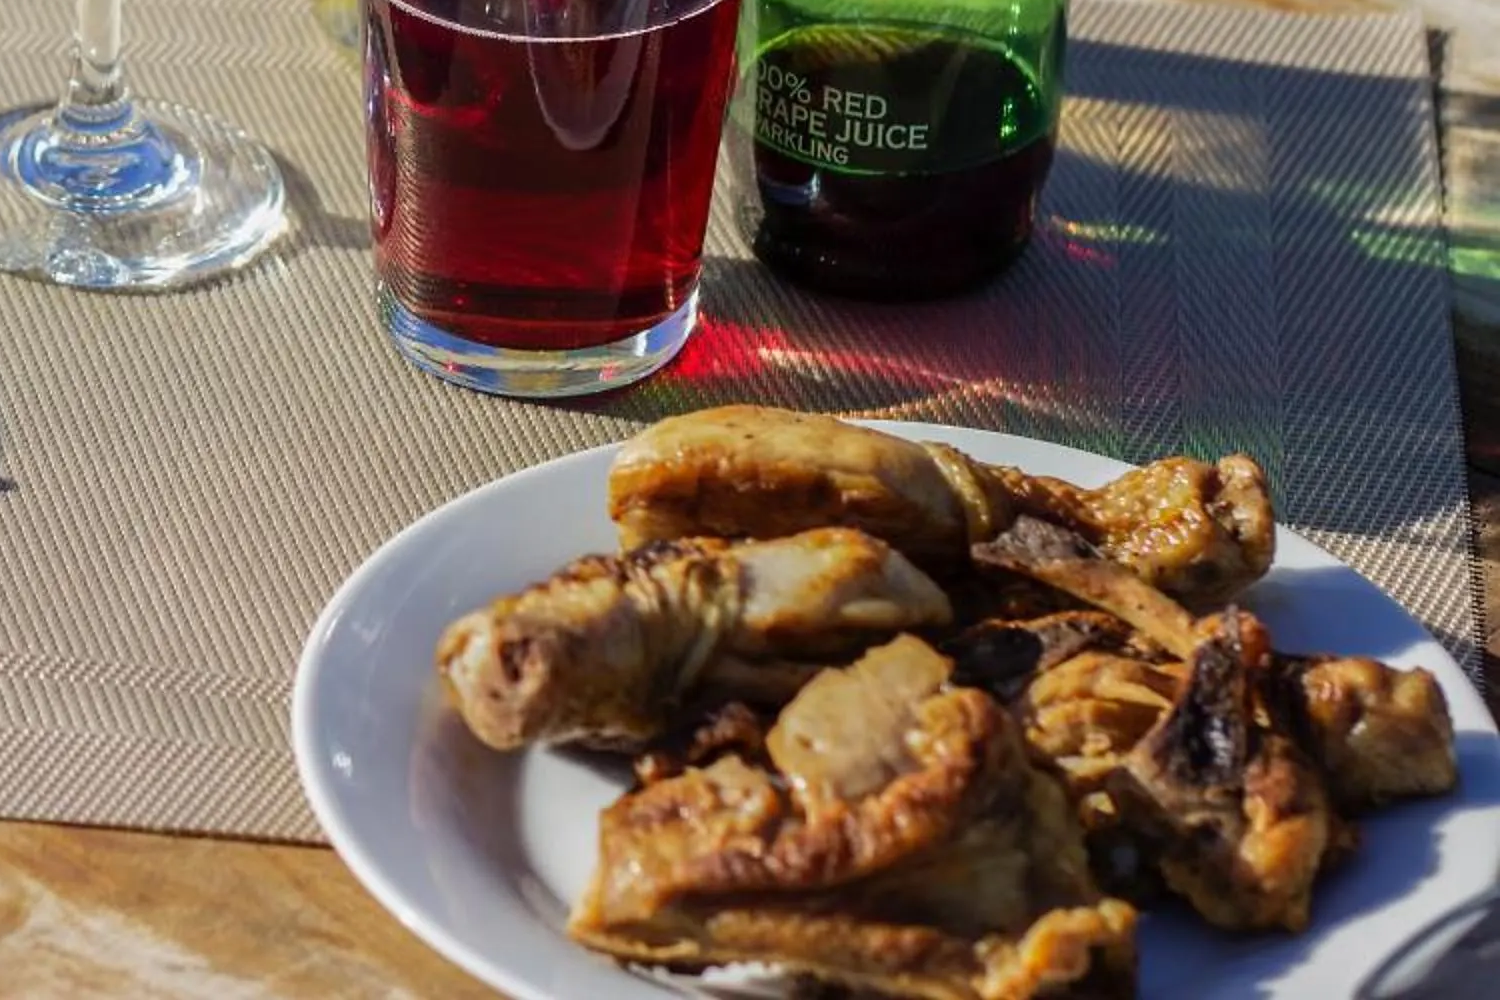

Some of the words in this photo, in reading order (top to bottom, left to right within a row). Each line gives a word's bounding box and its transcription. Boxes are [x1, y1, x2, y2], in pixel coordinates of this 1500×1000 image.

[758, 87, 827, 138] RAPE
[835, 119, 929, 149] JUICE
[822, 85, 887, 119] RED
[757, 115, 849, 165] ARKLING
